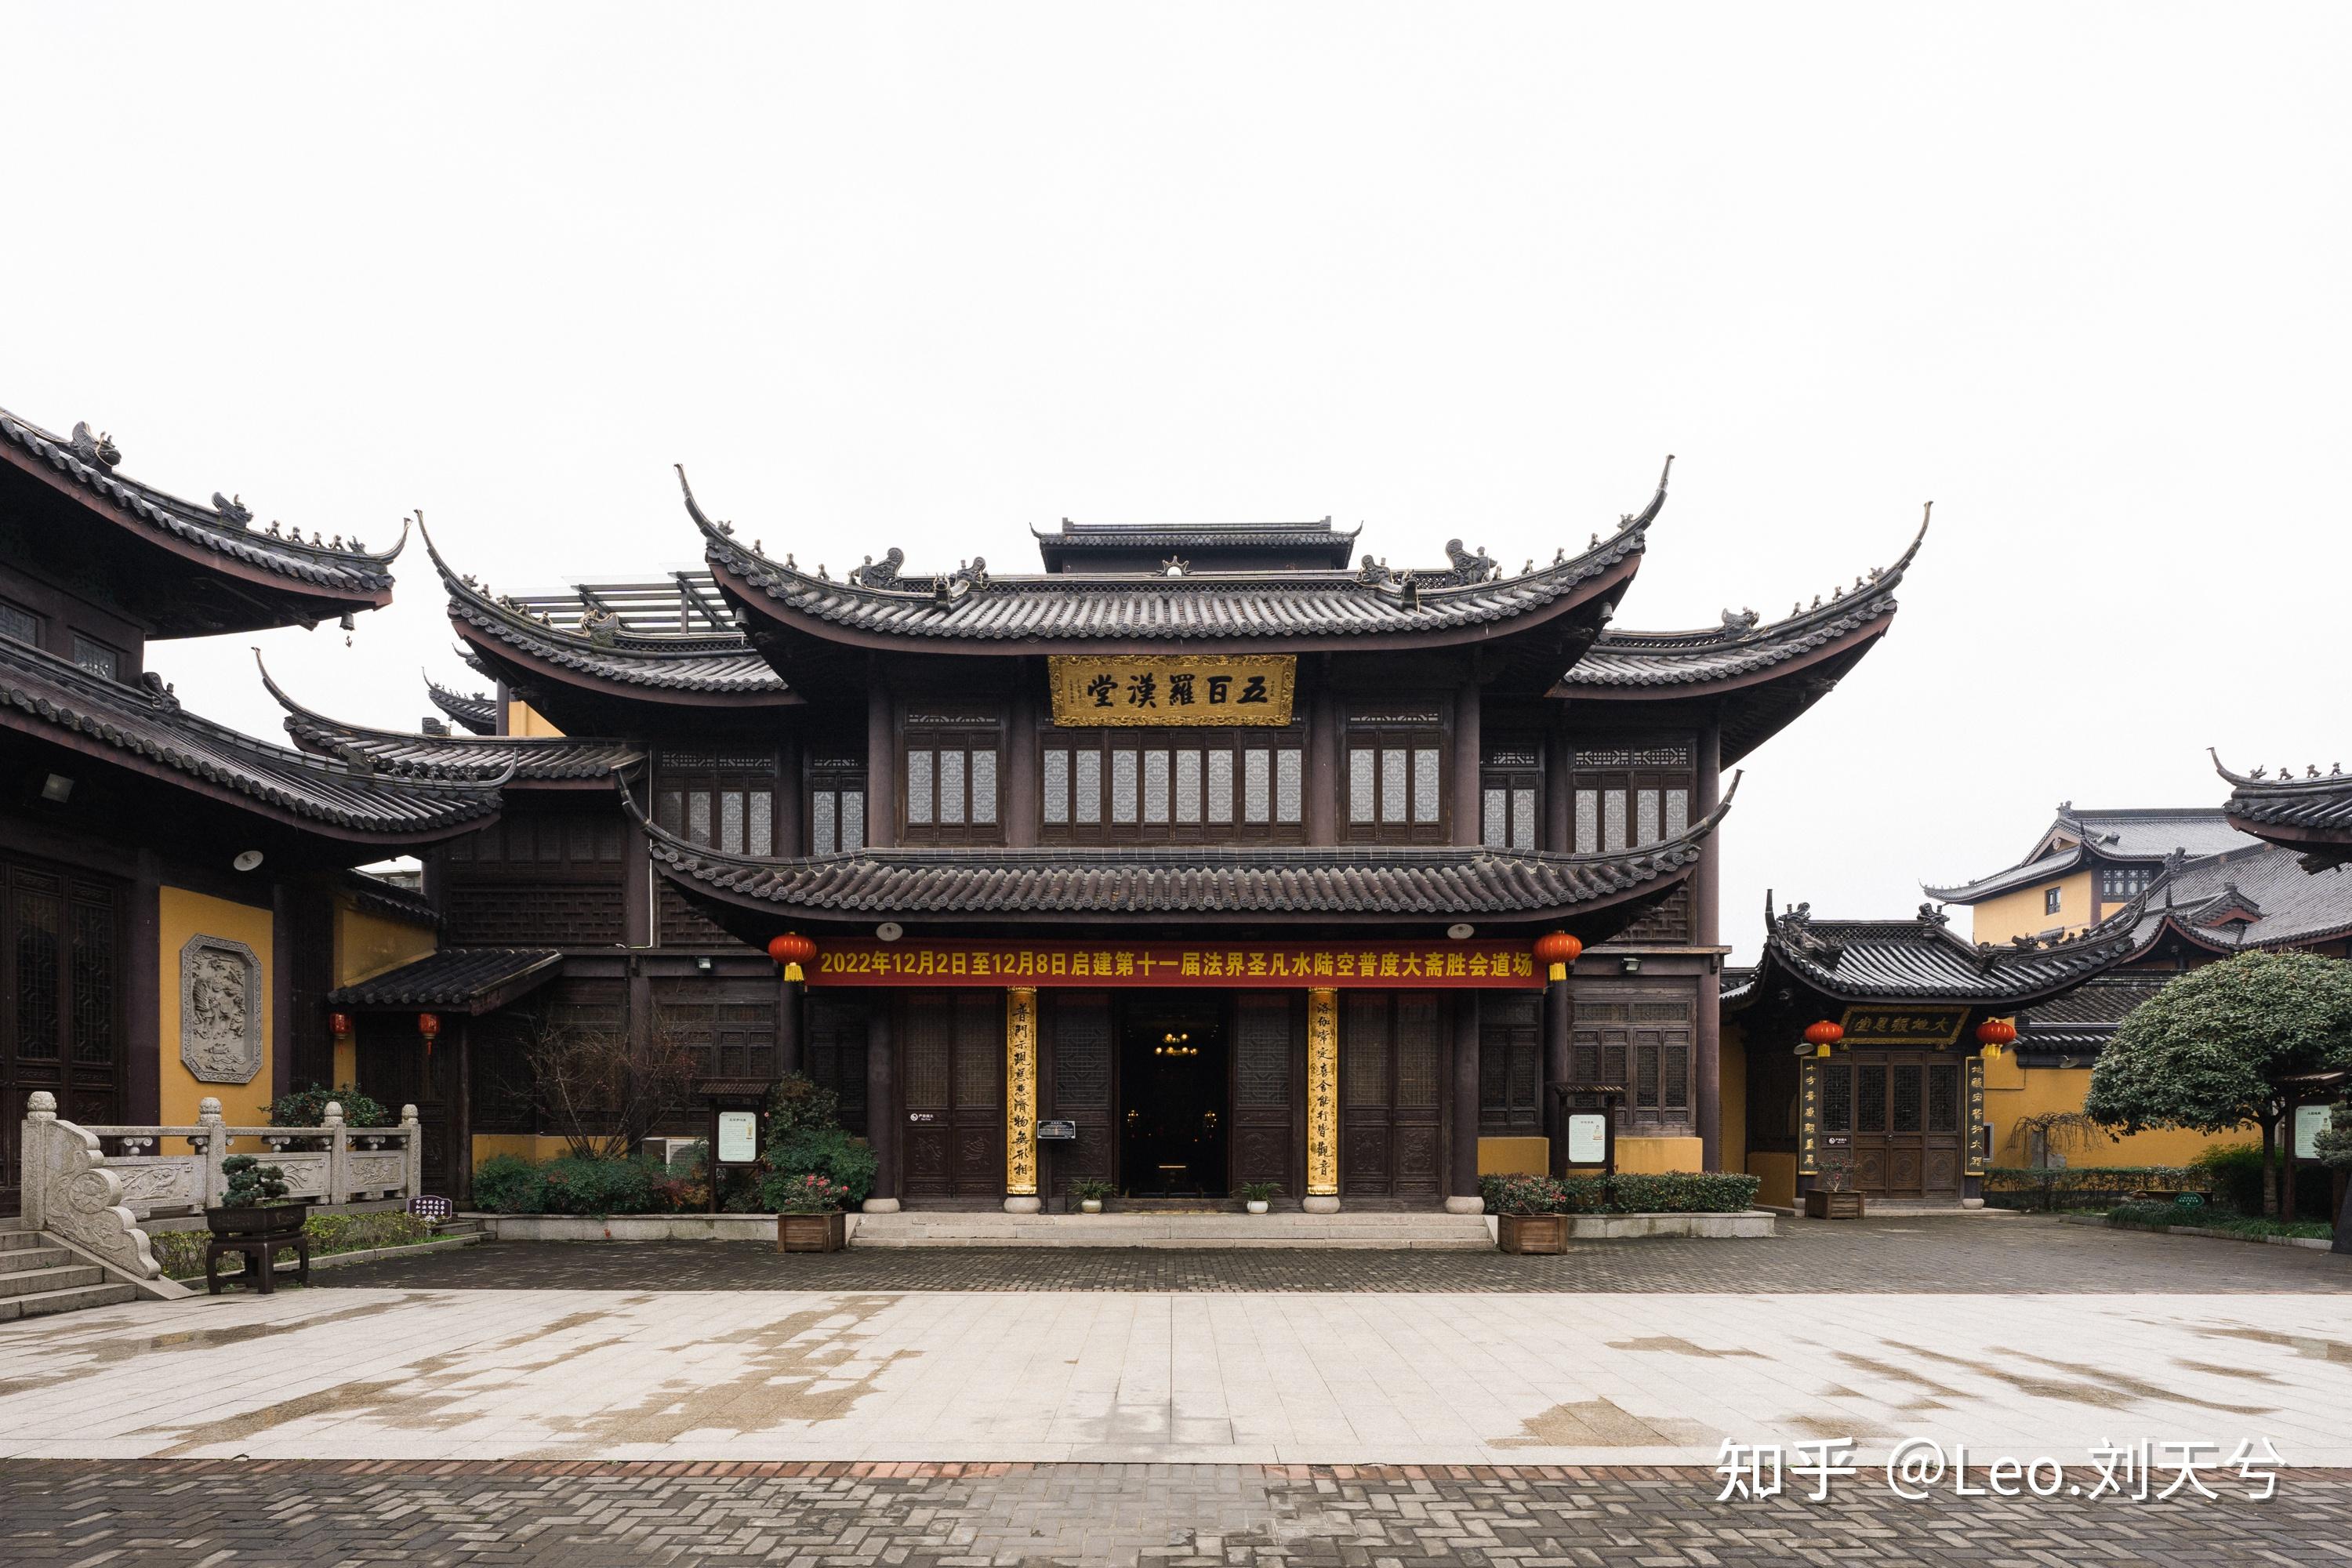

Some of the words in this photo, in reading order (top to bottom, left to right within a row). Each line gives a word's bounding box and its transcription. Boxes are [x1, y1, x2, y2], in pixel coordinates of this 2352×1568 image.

[820, 950, 1534, 978] 2022年12月2日至12月8日启建第十一届法界圣凡水陆空普度大斋胜会道场
